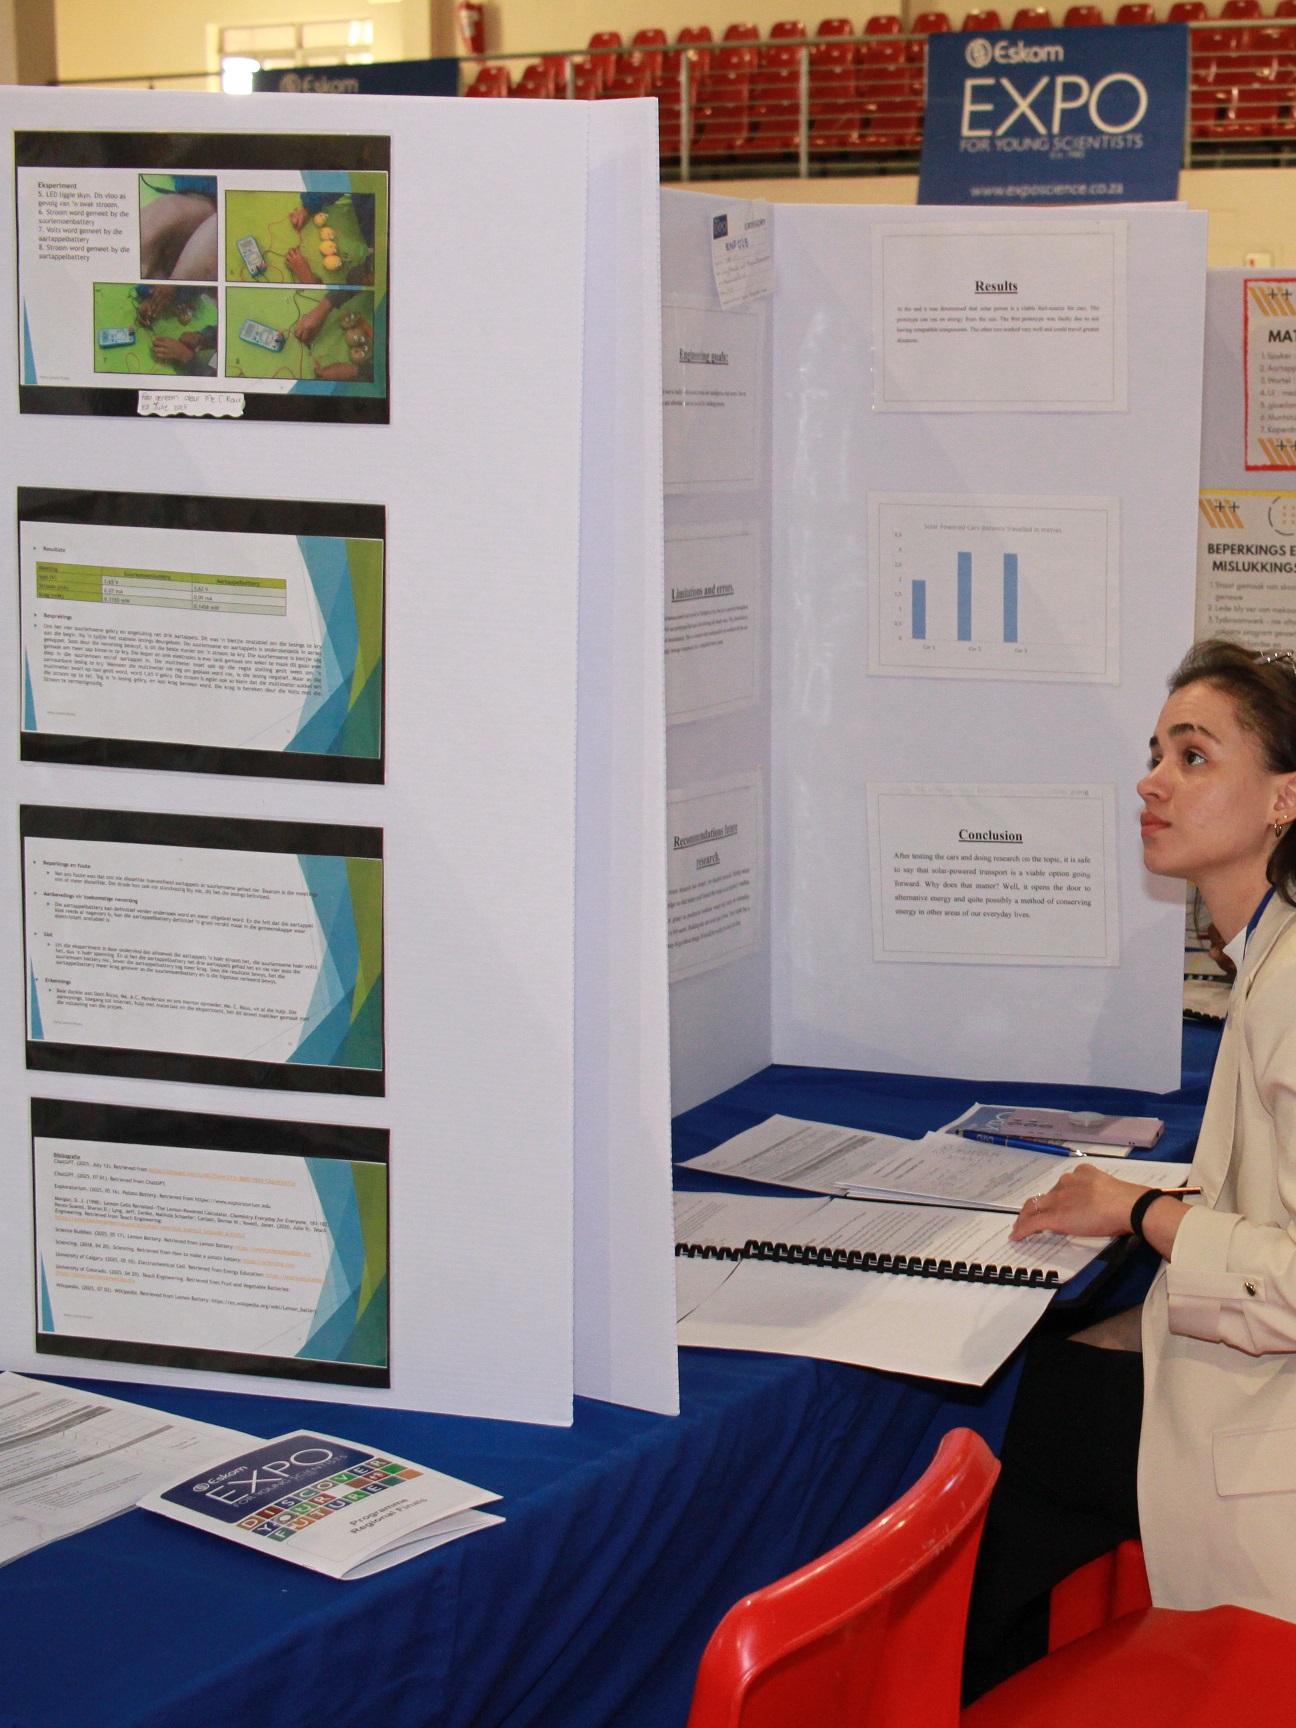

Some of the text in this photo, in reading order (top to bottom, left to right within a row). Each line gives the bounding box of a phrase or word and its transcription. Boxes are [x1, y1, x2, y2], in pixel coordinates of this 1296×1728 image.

[994, 40, 1064, 63] Eskom
[961, 72, 1148, 136] EXPO
[960, 134, 1143, 152] FOR YOUNG SCIENTISTS
[971, 183, 1123, 198] www.exposcience.co.za
[975, 280, 1018, 292] Results
[1207, 543, 1286, 556] BEPERKINGS
[959, 829, 1022, 841] Conclusion
[932, 868, 976, 876] solar-powered
[925, 881, 939, 889] Why
[930, 895, 951, 903] energy
[967, 896, 983, 904] quite
[985, 896, 1012, 905] possibly
[1056, 899, 1091, 907] conserving
[983, 910, 1012, 919] everyday
[205, 1448, 333, 1505] EXPO
[208, 1465, 248, 1485] Eskom
[233, 1492, 257, 1508] FOR
[245, 1458, 388, 1529] DISCOVER
[258, 1494, 330, 1535] YOUR
[276, 1485, 383, 1538] FUTURE
[349, 1498, 409, 1526] Programme
[350, 1510, 395, 1535] Regional
